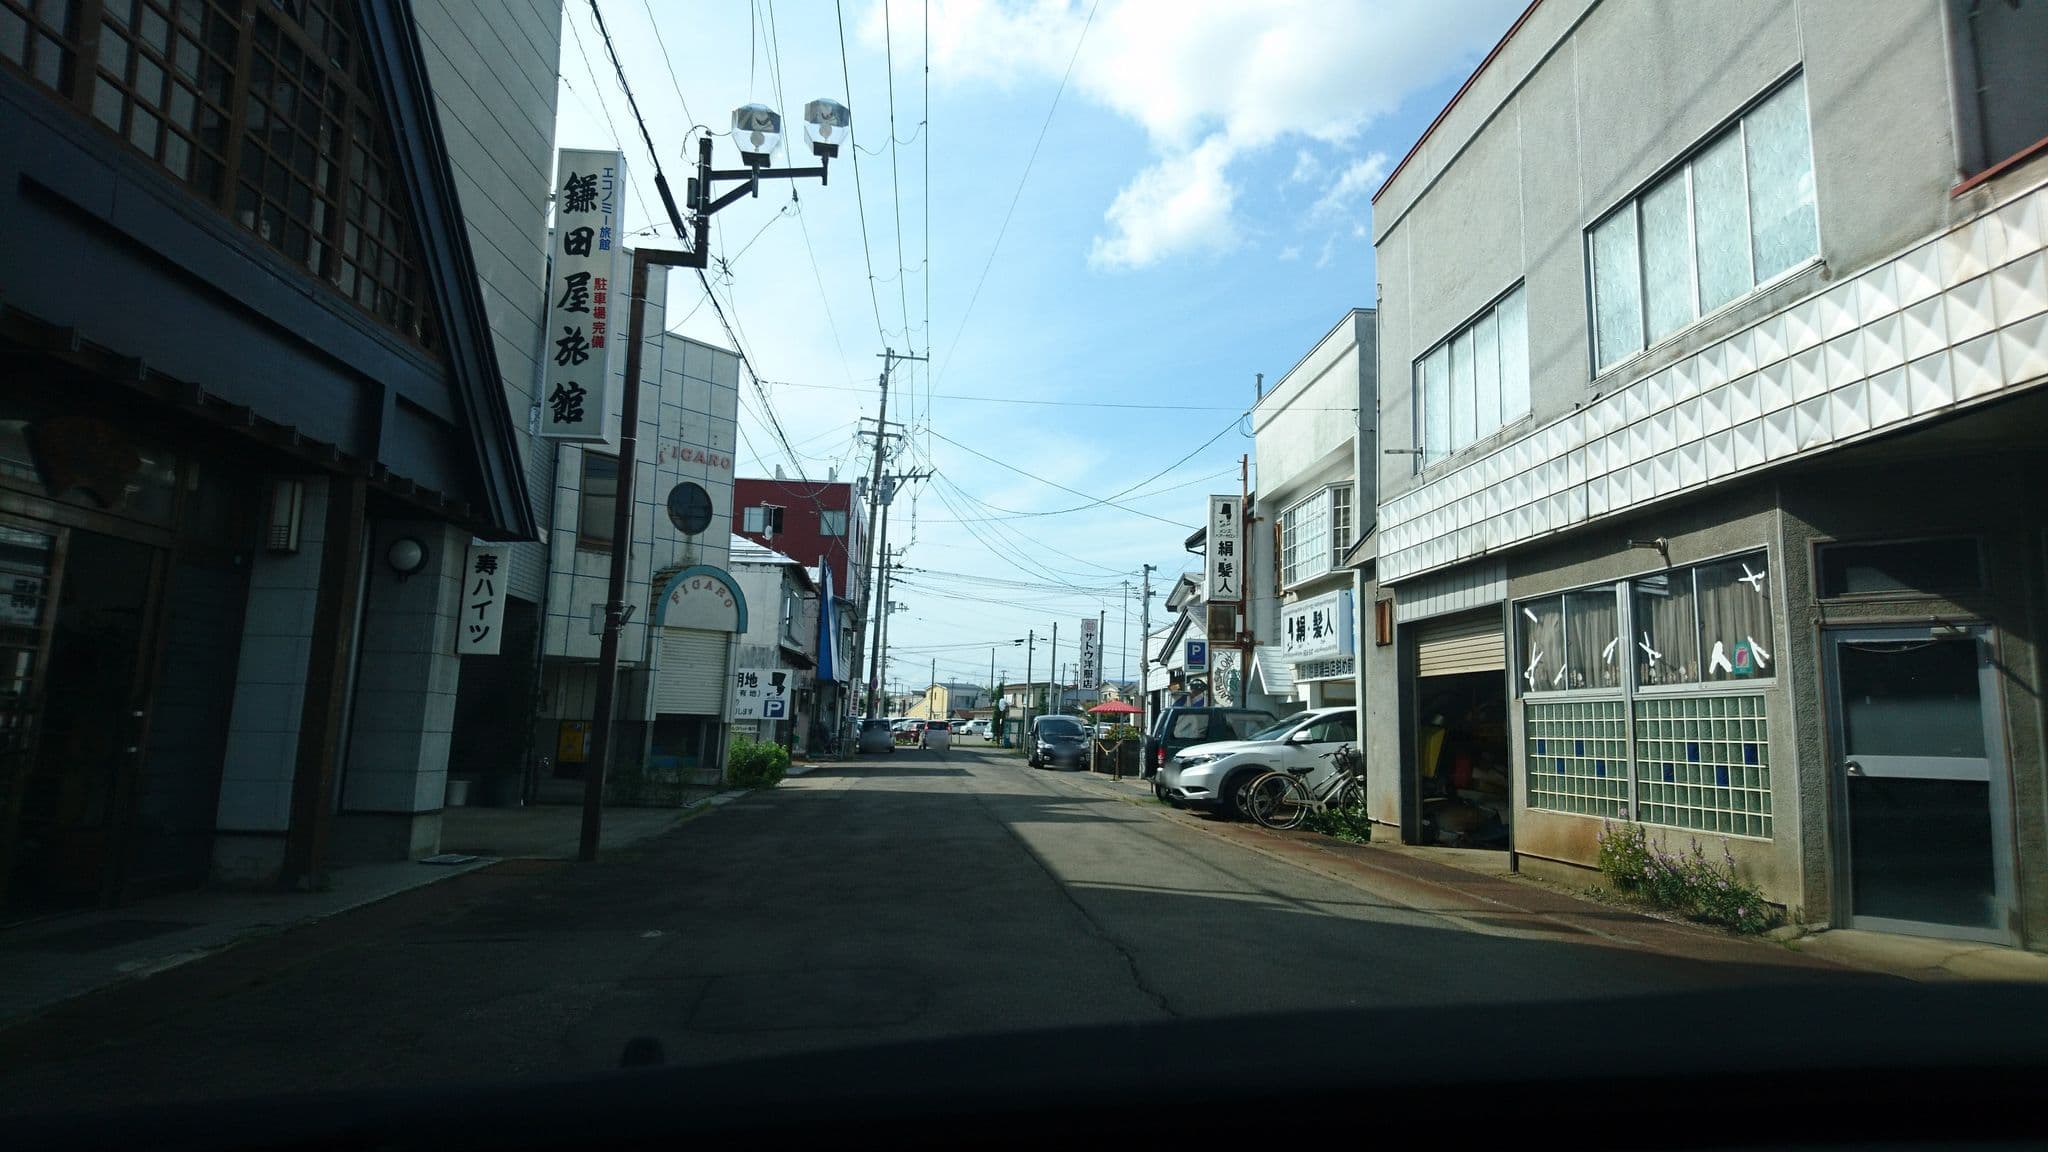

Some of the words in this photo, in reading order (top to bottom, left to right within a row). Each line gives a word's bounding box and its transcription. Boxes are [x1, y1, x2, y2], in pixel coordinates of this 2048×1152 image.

[599, 167, 614, 251] エコノミー旅館
[549, 171, 599, 424] 鎌田屋旅館
[592, 277, 608, 349] 駐車場完備
[469, 553, 498, 644] 寿ハイツ
[671, 578, 734, 609] FIGARO
[1082, 632, 1095, 689] サトウ洋服店
[1192, 645, 1202, 656] P
[766, 701, 782, 717] P
